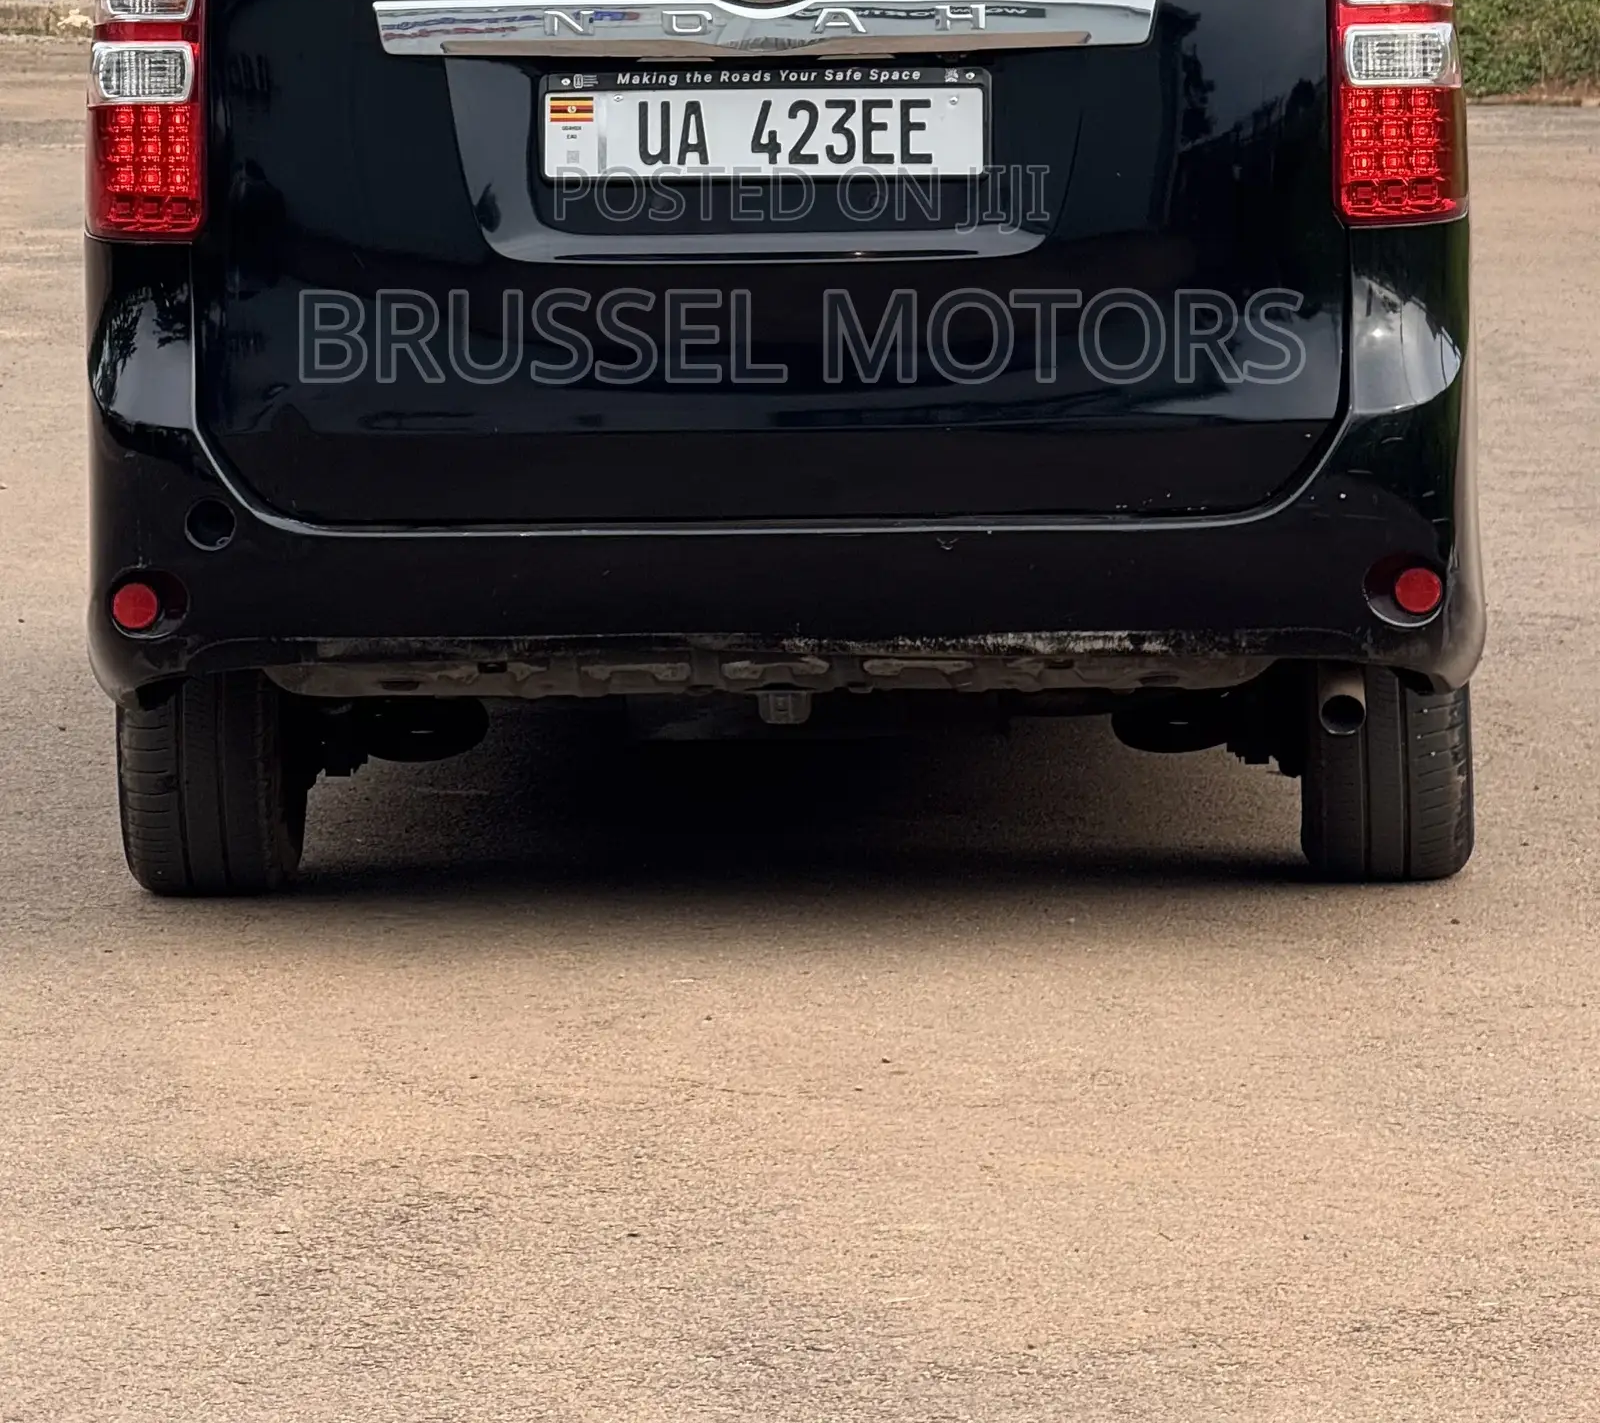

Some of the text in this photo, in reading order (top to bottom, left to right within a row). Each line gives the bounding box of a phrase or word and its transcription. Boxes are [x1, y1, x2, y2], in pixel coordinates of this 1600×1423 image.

[543, 4, 987, 35] NOAH
[616, 68, 921, 86] Making the Roads Your Safe Space
[638, 98, 933, 166] UA 423EE
